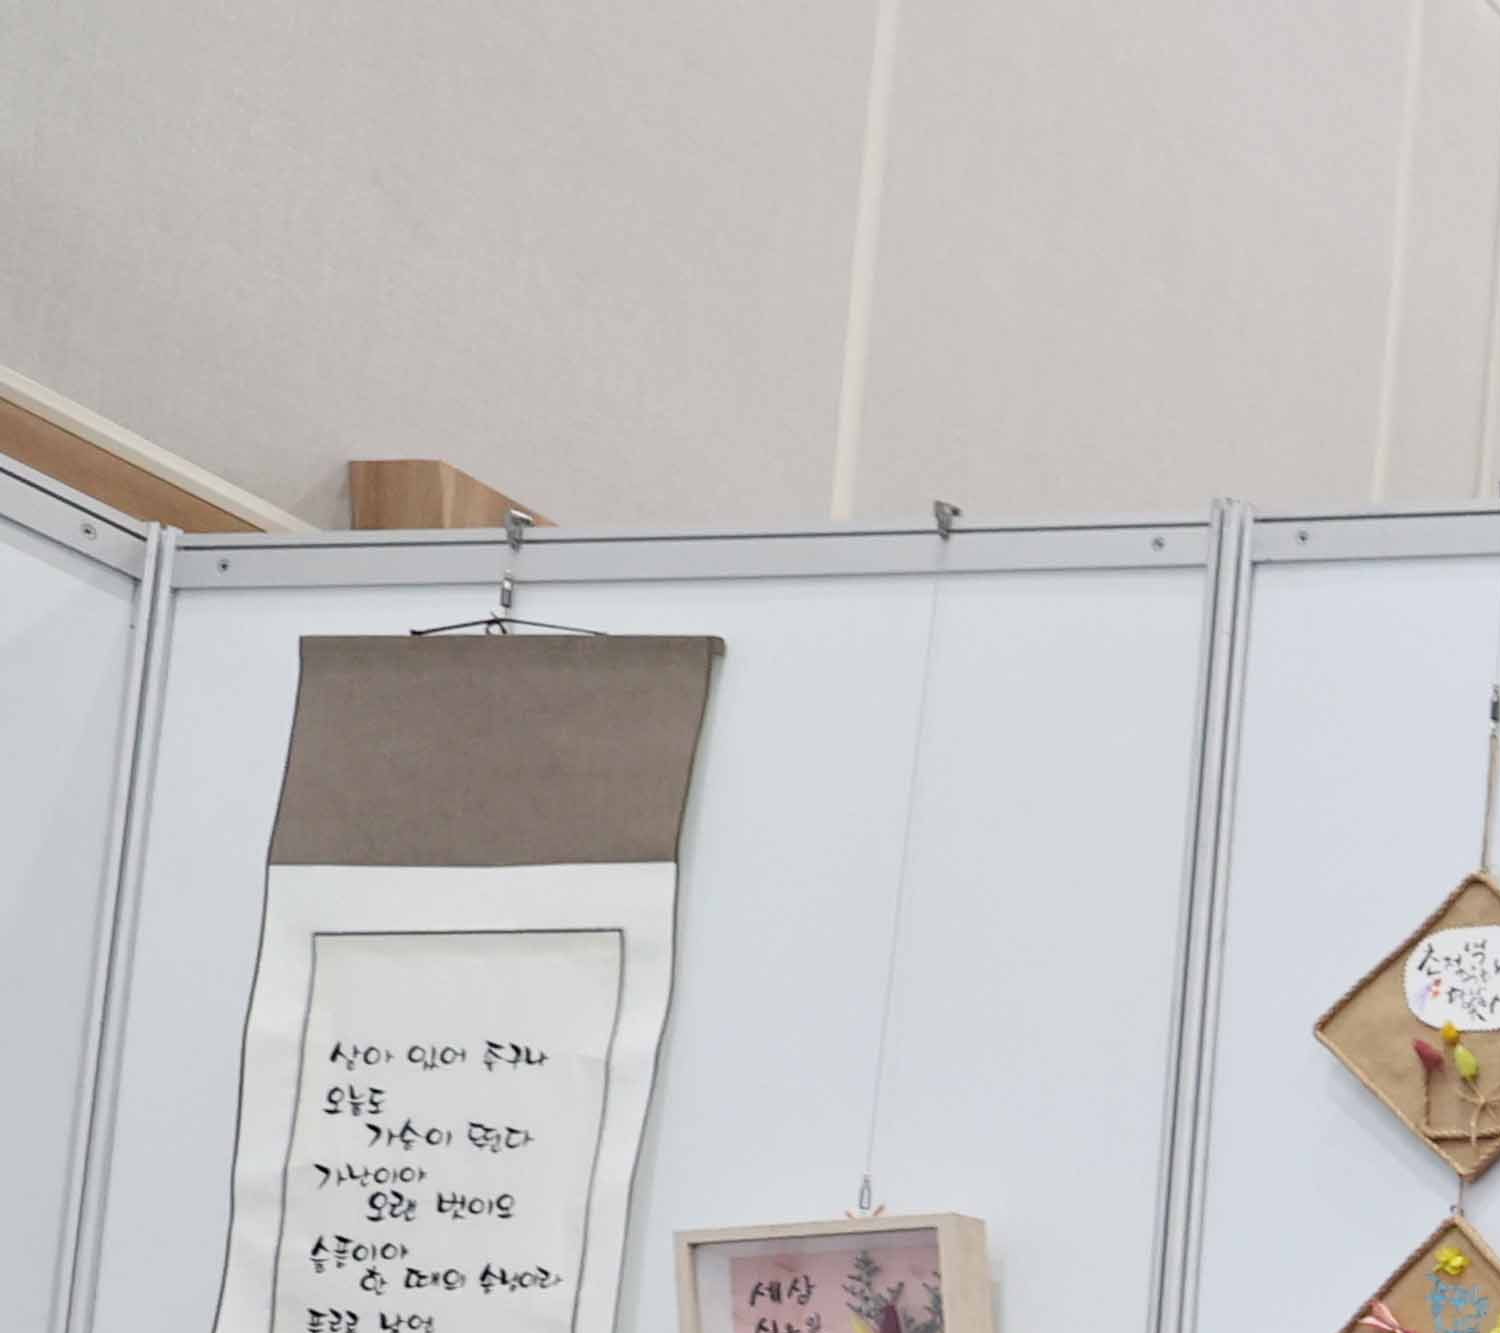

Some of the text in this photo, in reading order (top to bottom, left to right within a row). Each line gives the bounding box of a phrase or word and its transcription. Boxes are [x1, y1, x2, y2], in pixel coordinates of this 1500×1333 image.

[330, 1041, 394, 1072] 살아
[407, 1045, 467, 1072] 있어
[323, 1084, 385, 1117] 오늘도
[750, 1275, 815, 1306] 세상
